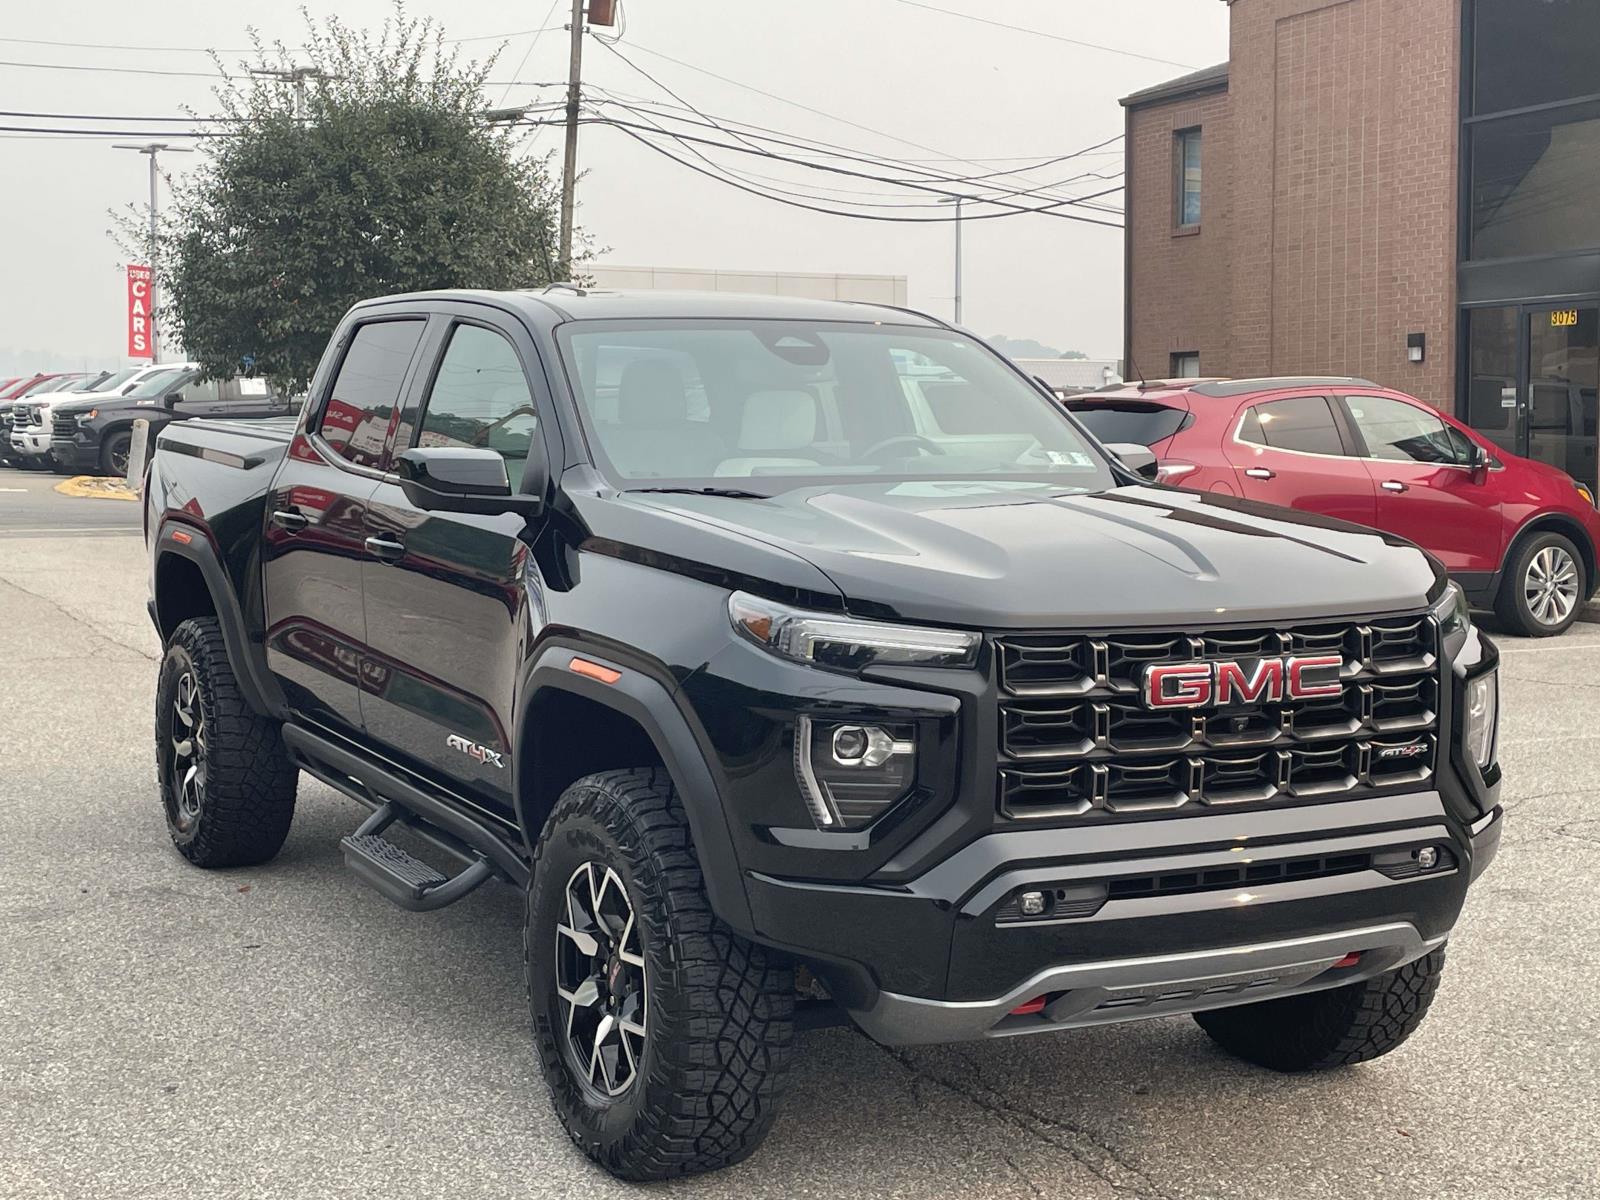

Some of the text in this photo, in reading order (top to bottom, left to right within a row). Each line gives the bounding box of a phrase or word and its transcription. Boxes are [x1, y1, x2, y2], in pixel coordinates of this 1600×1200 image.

[132, 280, 146, 351] CARS
[1552, 310, 1576, 325] 3075
[1145, 655, 1343, 710] GMC
[446, 734, 505, 768] AT4X
[1380, 742, 1428, 758] AT4X
